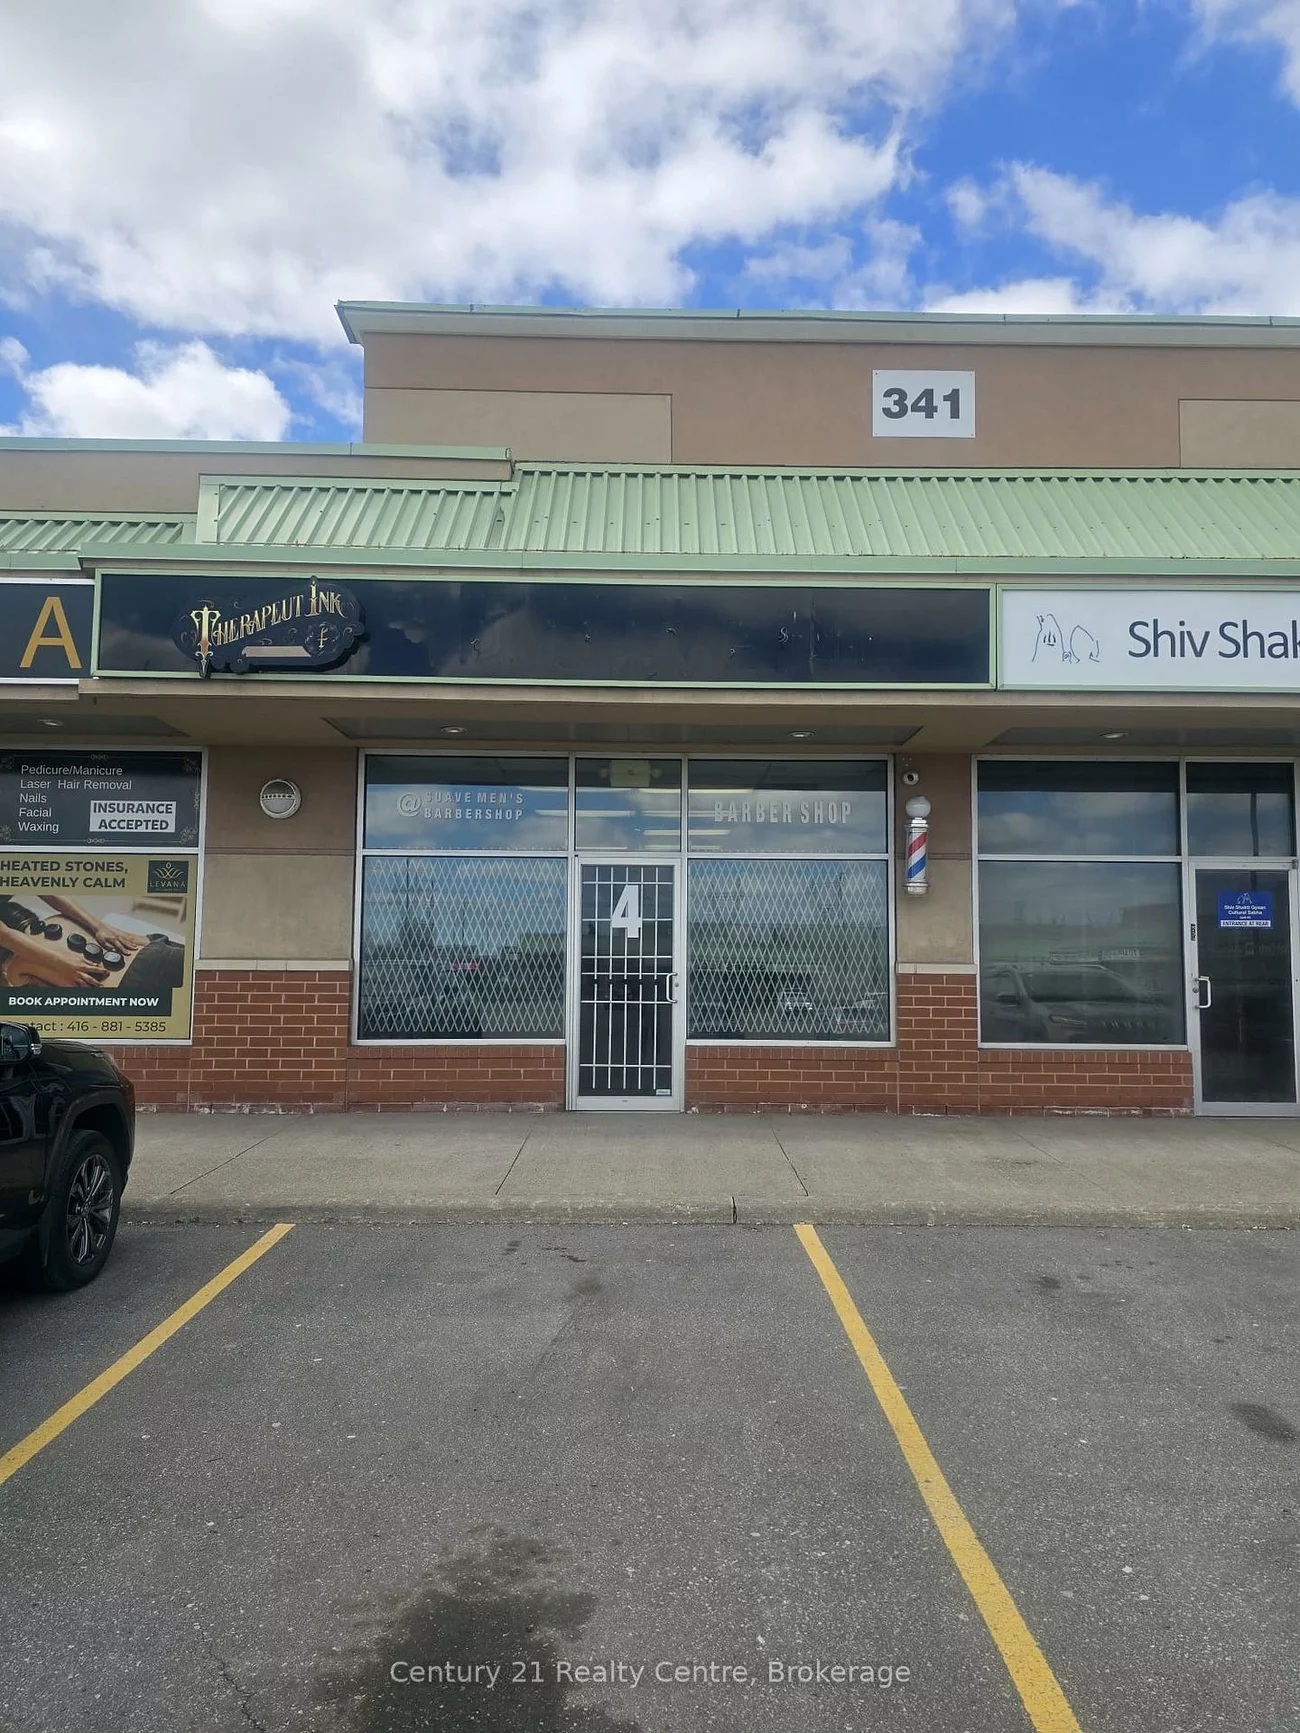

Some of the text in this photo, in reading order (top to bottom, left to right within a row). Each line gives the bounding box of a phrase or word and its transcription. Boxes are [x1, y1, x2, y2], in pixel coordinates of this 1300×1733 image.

[881, 387, 960, 419] 341
[19, 596, 82, 669] A
[1128, 618, 1210, 658] Shiv
[21, 765, 123, 776] Pedicure/Manicure
[20, 779, 132, 790] Laser Hair Removal
[19, 793, 47, 803] Nails
[425, 792, 471, 803] SUAVE
[477, 792, 523, 804] MEN'S
[19, 807, 52, 818] Facial
[93, 802, 173, 814] INSURANCE
[424, 808, 523, 820] BARBERSHOP
[714, 800, 851, 824] BARBER SHOP
[18, 821, 59, 834] Waxing
[98, 819, 169, 830] ACCEPTED
[0, 860, 128, 874] HEATED STONES,
[0, 876, 126, 888] HEAVENLY CALM
[149, 880, 186, 888] LEVANA
[611, 884, 643, 938] 4
[8, 997, 159, 1007] BOOK APPOINTMENT NOW
[67, 1021, 89, 1032] 416
[101, 1021, 123, 1032] 881
[135, 1021, 166, 1032] 5385
